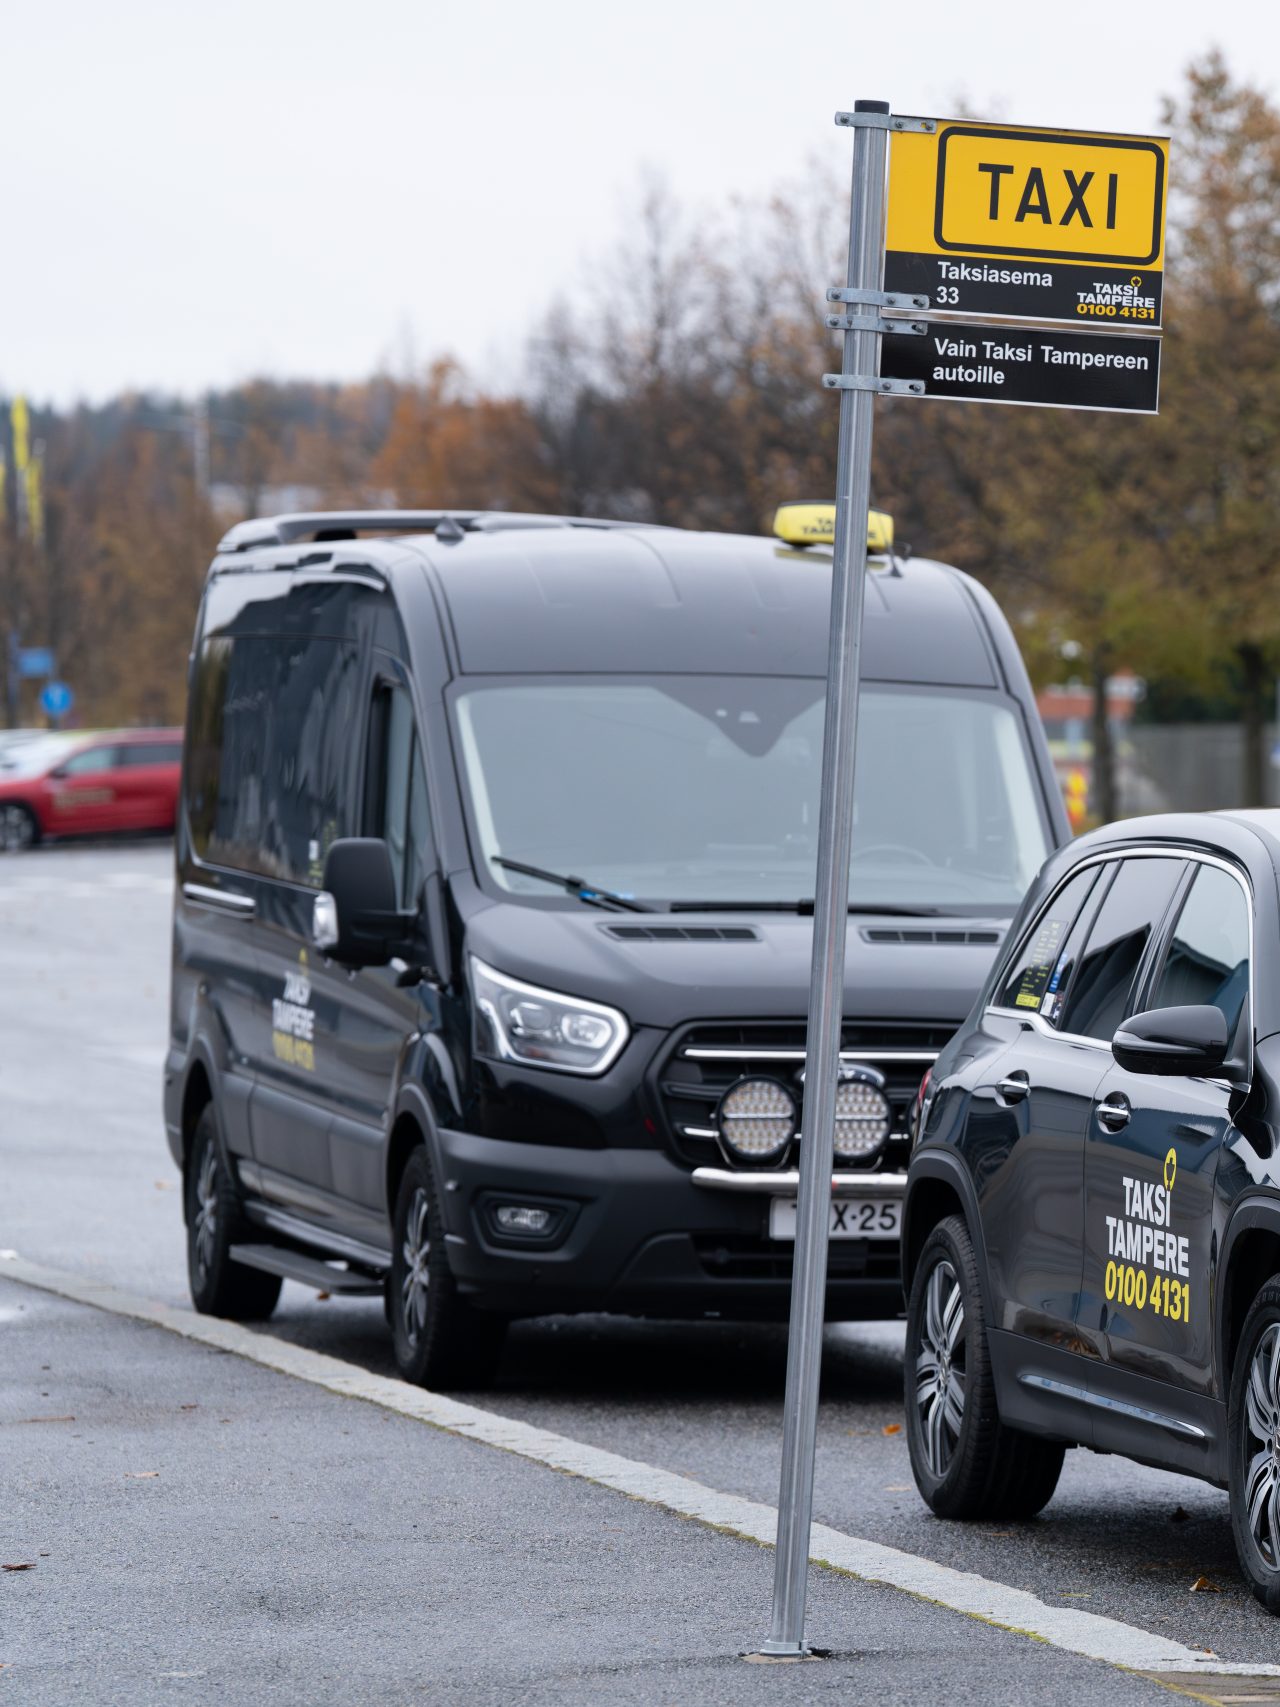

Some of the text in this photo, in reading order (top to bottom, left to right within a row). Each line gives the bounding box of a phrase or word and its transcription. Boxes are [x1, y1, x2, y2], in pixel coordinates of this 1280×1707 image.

[978, 162, 1118, 230] TAXI
[937, 261, 1053, 287] Taksiasema
[936, 285, 960, 304] 33
[1076, 292, 1156, 308] TAMPERE
[1092, 282, 1139, 297] TAKSI
[1076, 303, 1155, 319] 0100 4131
[934, 337, 1149, 370] Vain Taksi Tampereen
[932, 365, 1006, 384] autoille
[1122, 1176, 1171, 1227] TAKSI
[1105, 1215, 1190, 1278] TAMPERE
[1104, 1260, 1190, 1323] 0100 4131
